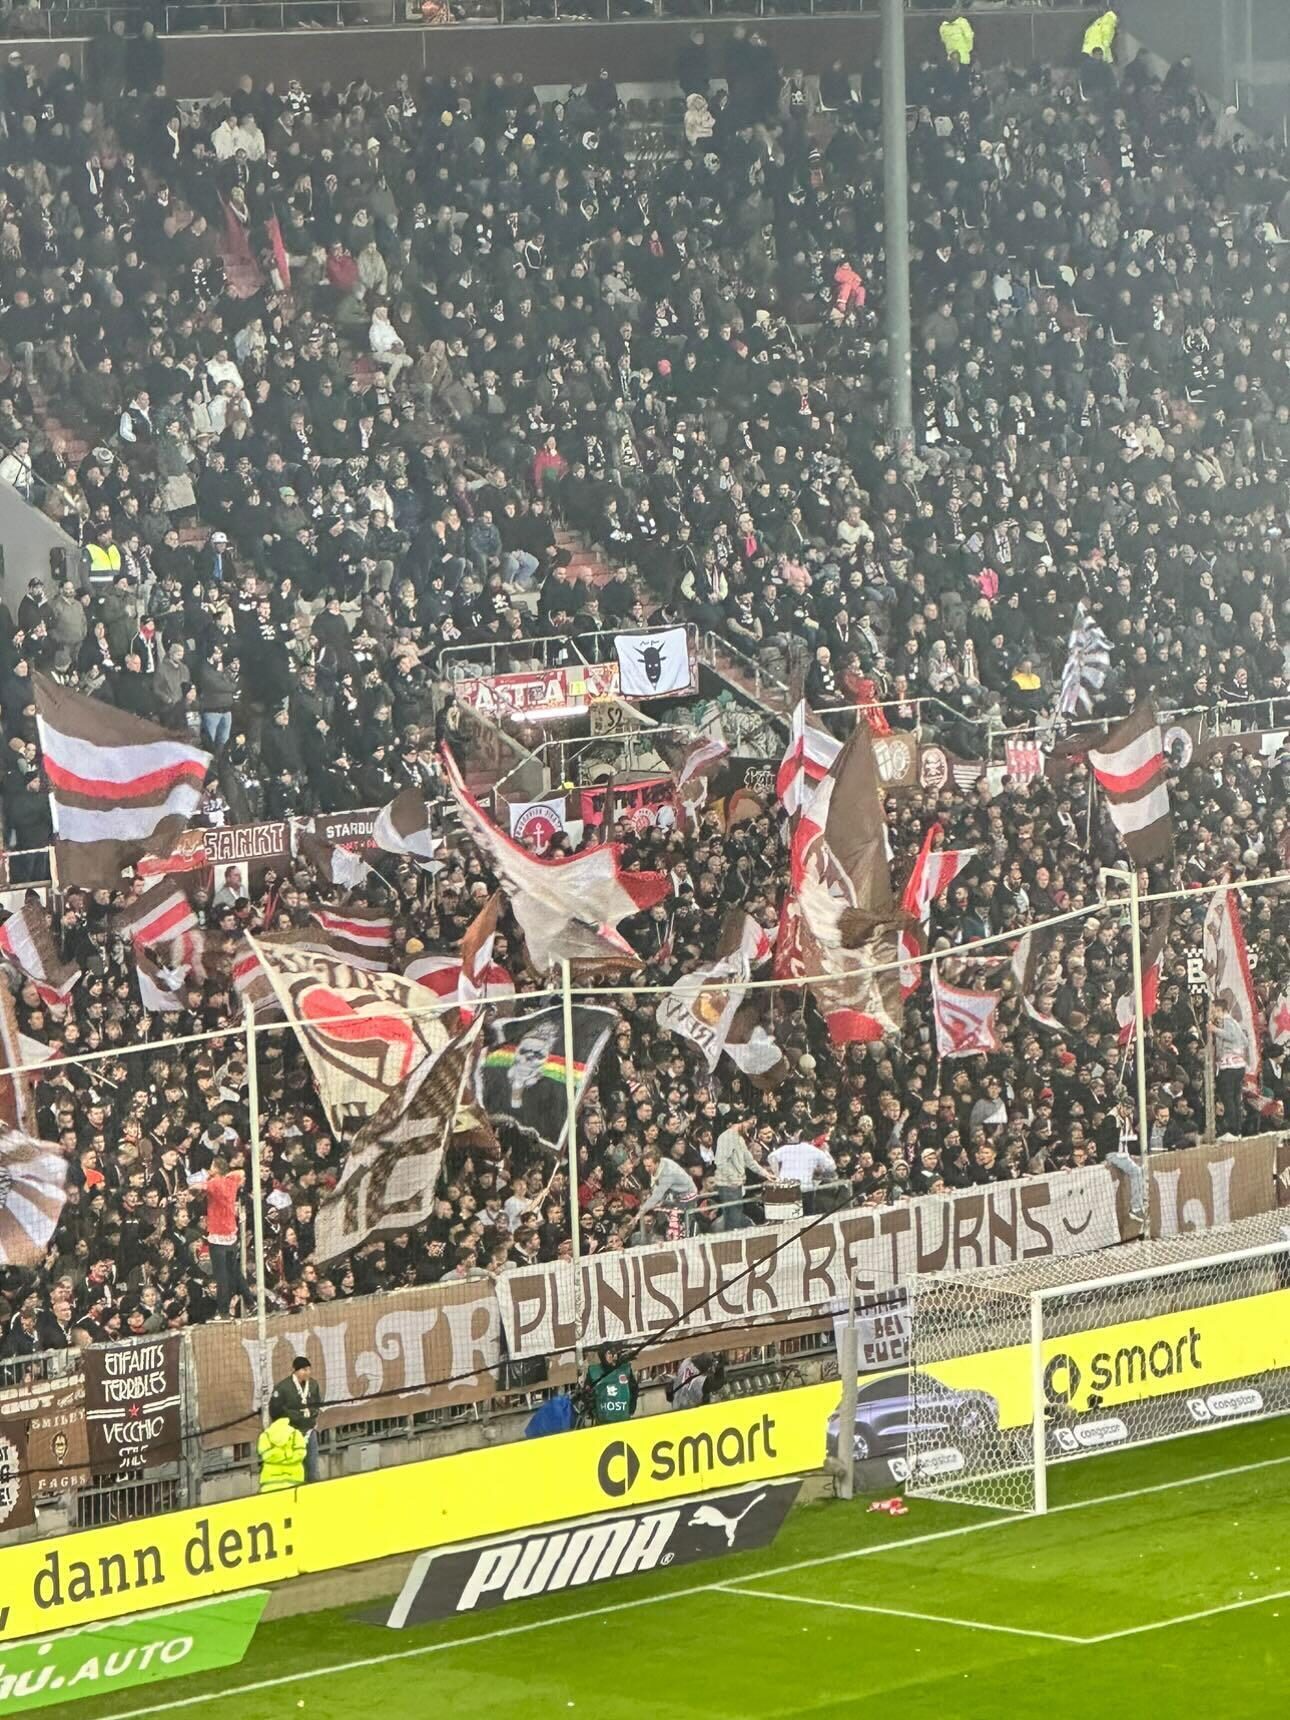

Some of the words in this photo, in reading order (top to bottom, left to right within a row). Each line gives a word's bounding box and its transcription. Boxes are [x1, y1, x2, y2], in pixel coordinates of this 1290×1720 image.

[203, 823, 286, 860] SANKT
[326, 822, 376, 838] STARDU
[509, 1233, 778, 1353] PUNISHER
[801, 1182, 1054, 1302] RETURNS
[1090, 1327, 1202, 1391] smart
[101, 1371, 166, 1402] TERRIBLES
[600, 1401, 627, 1412] HOST
[103, 1416, 164, 1444] VECCHIO
[651, 1413, 776, 1481] smart
[33, 1542, 165, 1608] dann
[184, 1517, 294, 1576] den:
